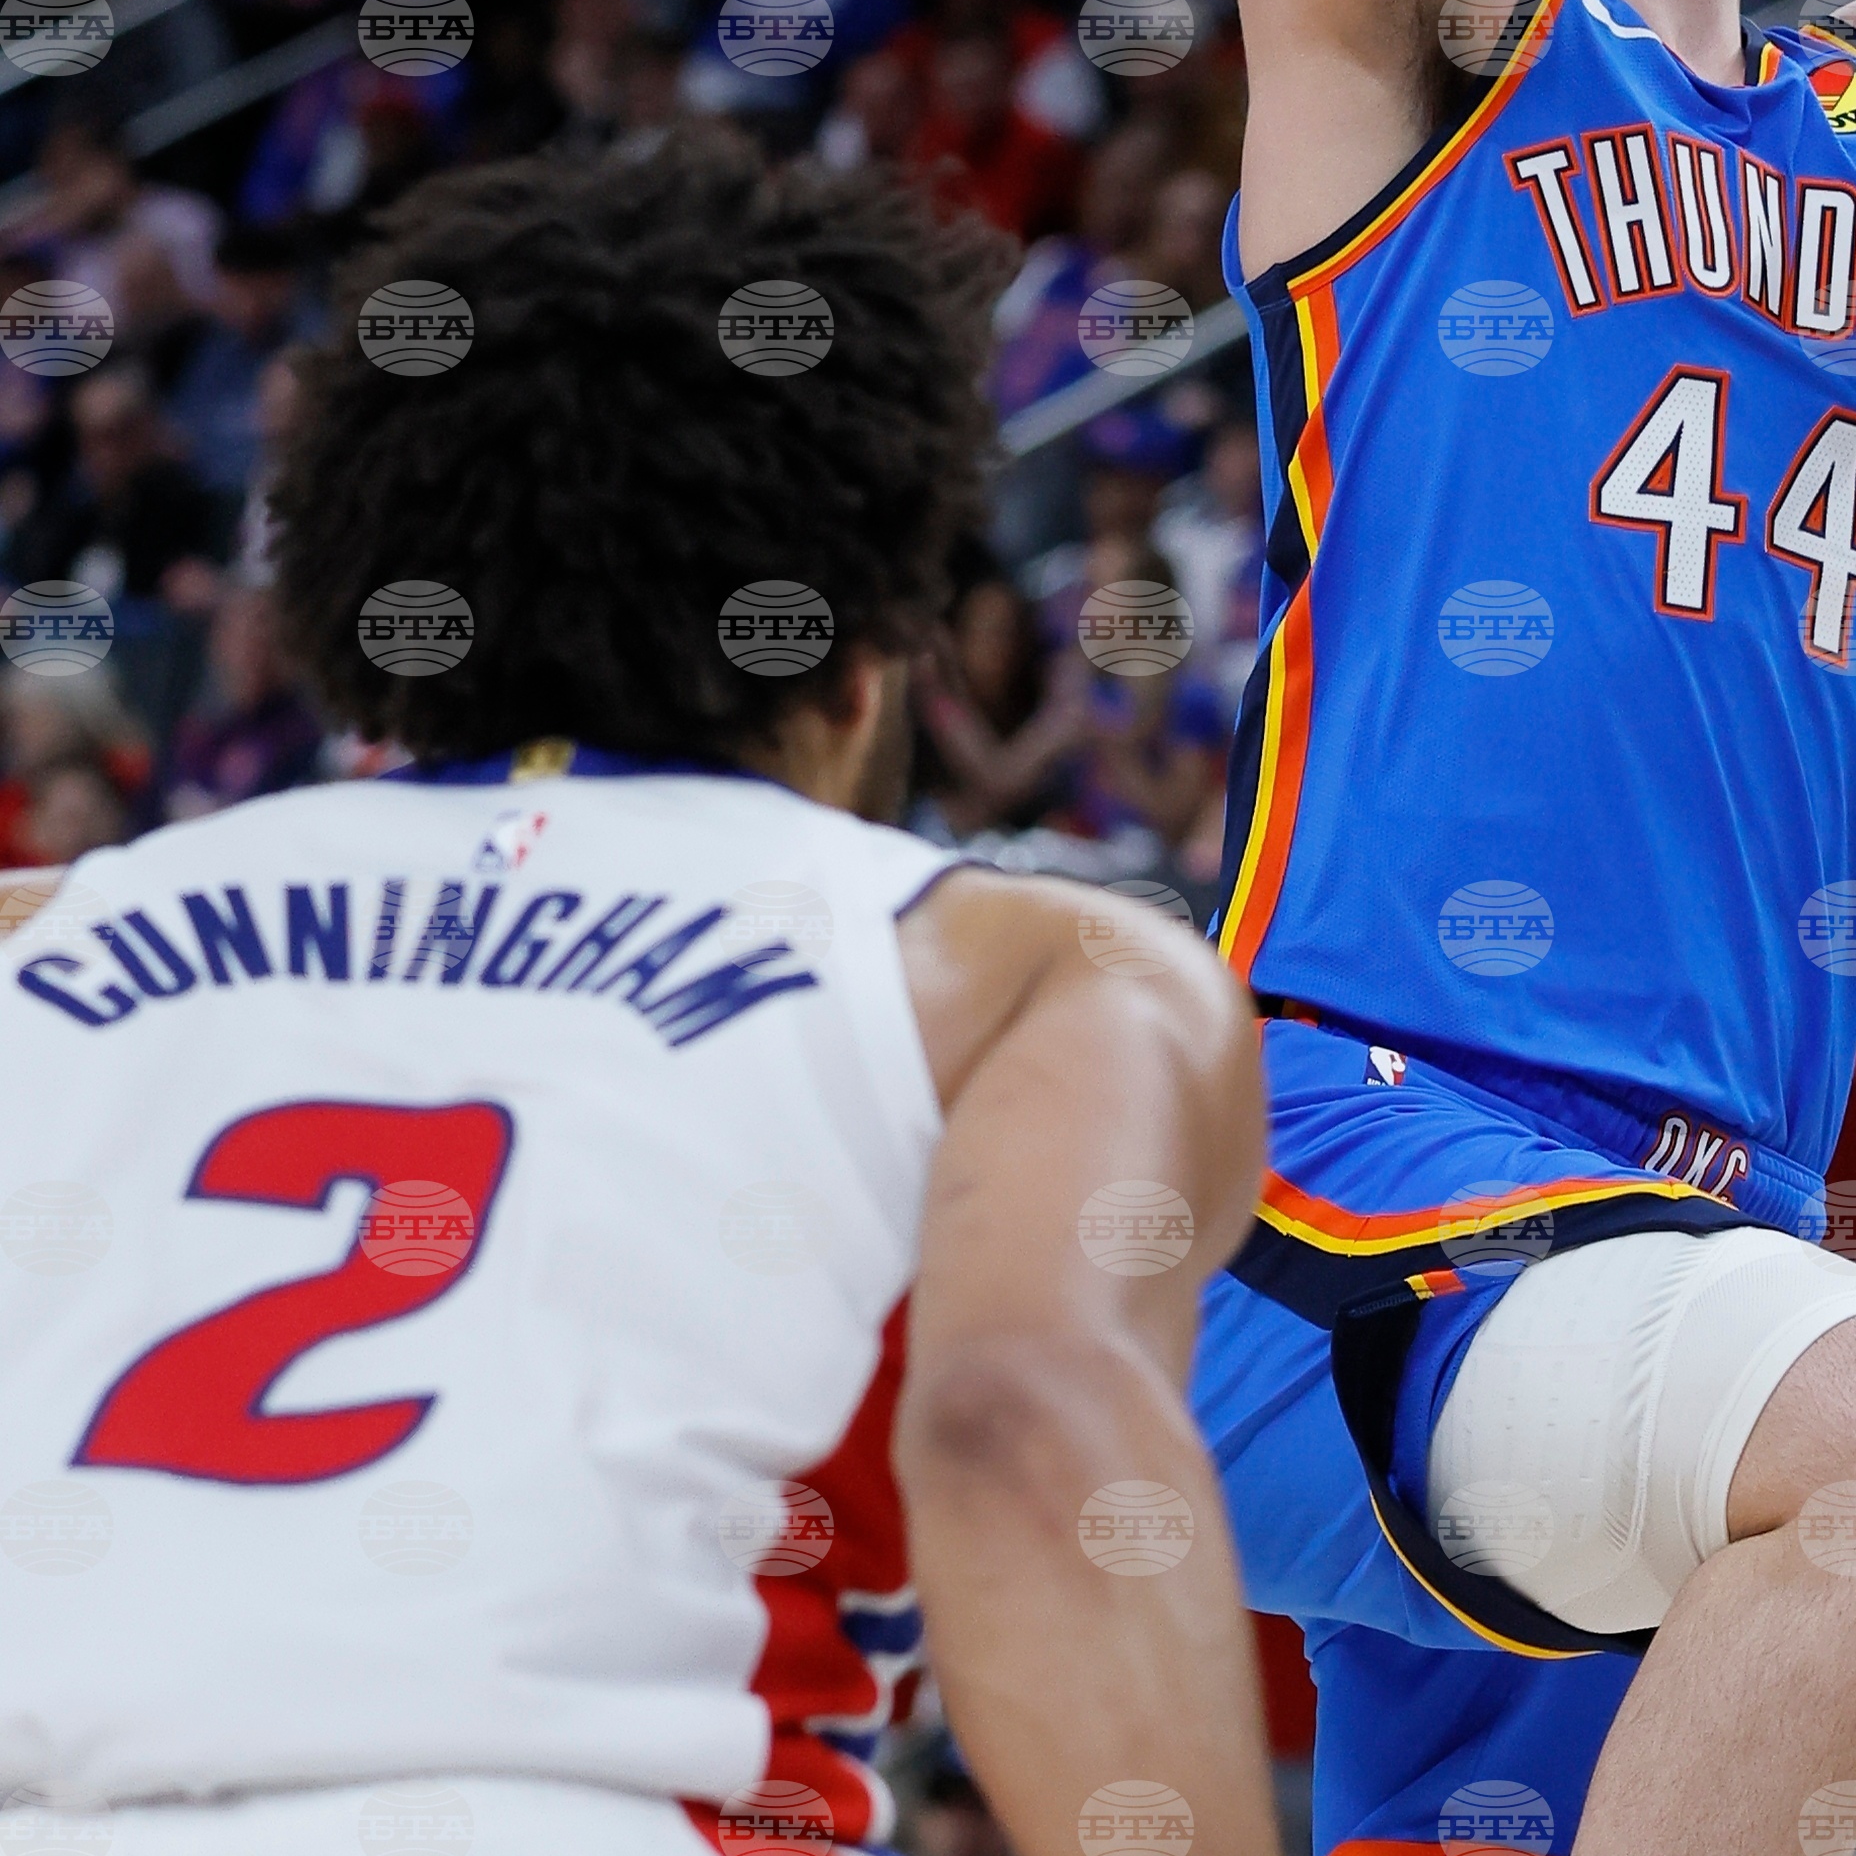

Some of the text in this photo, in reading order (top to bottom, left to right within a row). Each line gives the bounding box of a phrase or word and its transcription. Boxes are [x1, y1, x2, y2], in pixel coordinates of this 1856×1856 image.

[15, 876, 821, 1050] CUNNINGHAM
[1641, 1111, 1749, 1203] OKC
[69, 1097, 518, 1488] 2
